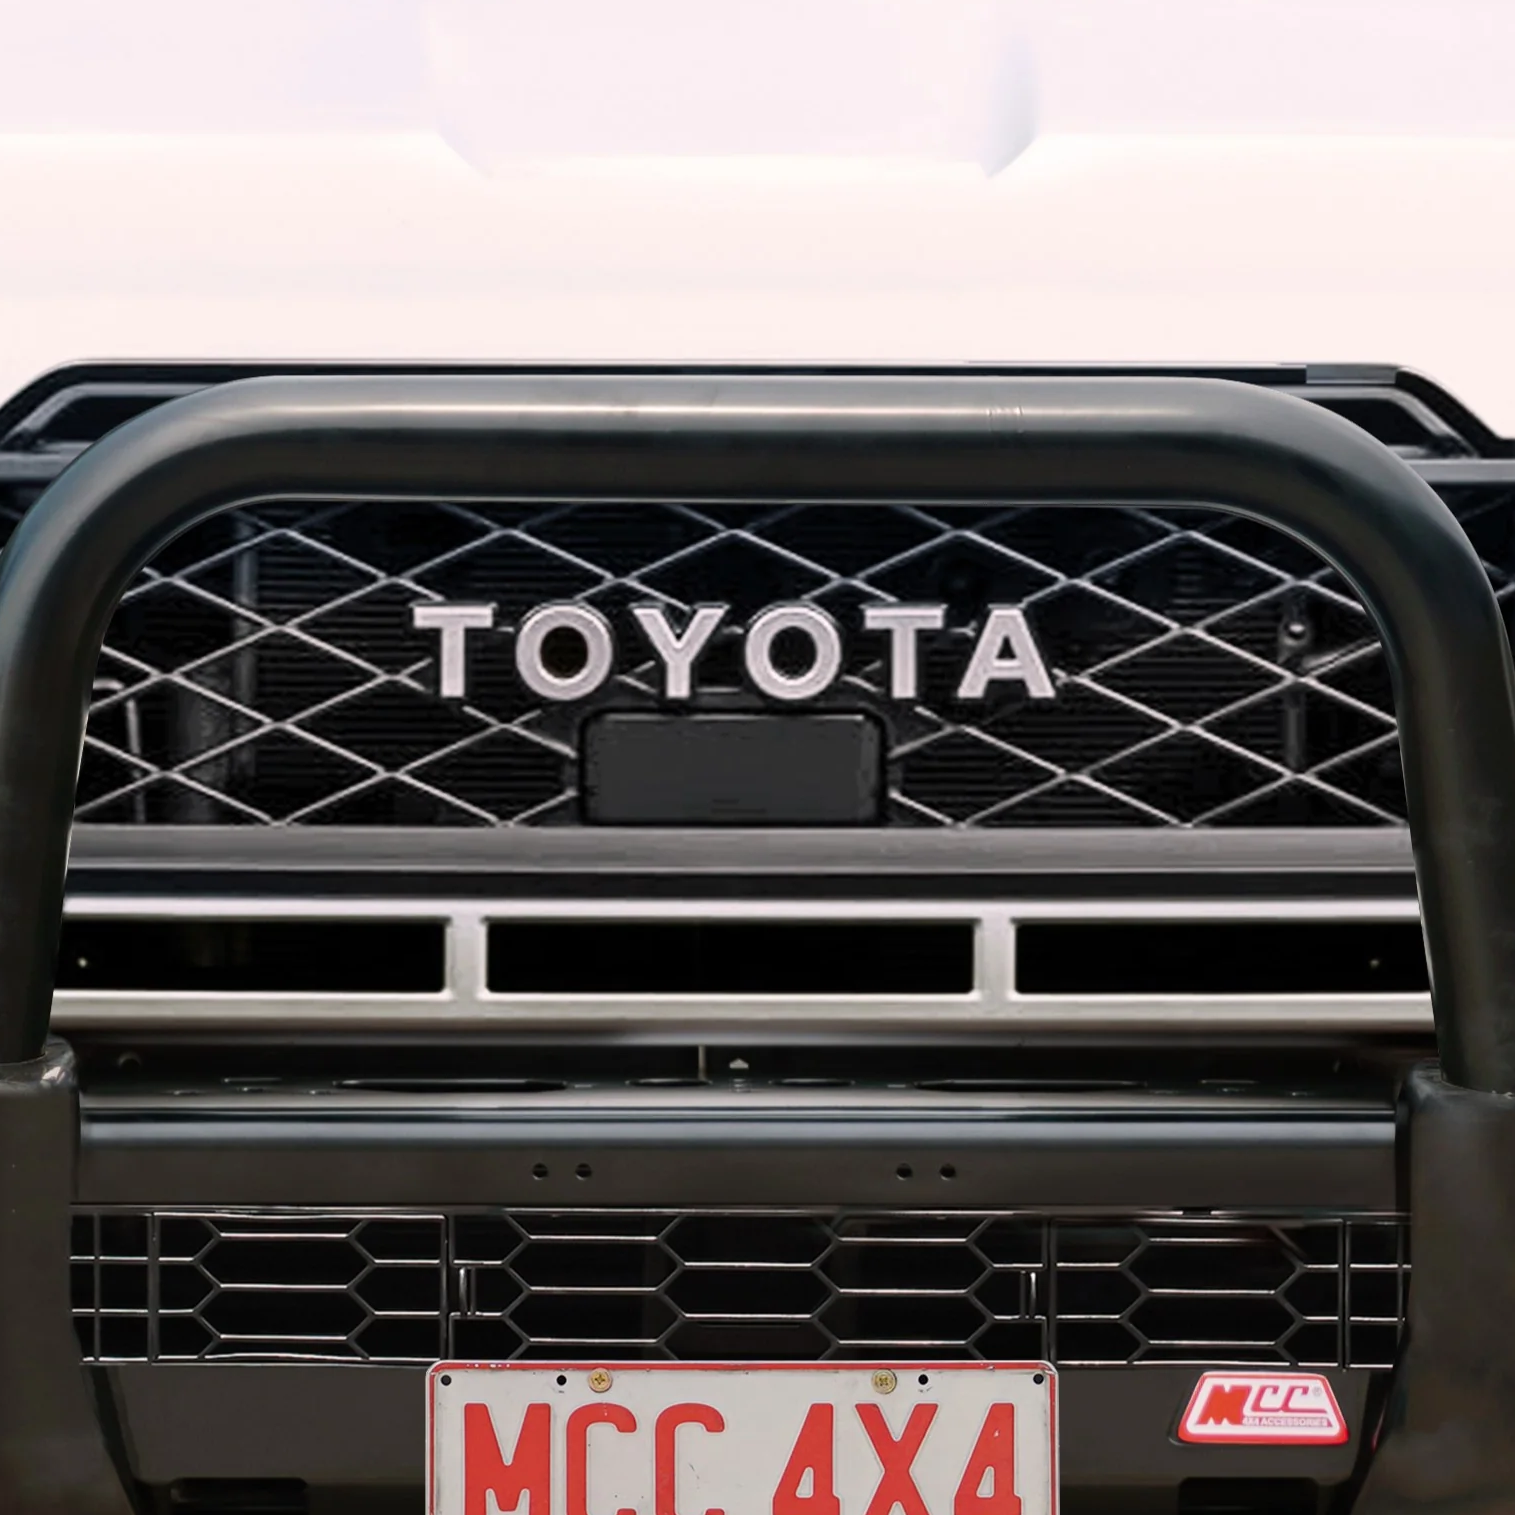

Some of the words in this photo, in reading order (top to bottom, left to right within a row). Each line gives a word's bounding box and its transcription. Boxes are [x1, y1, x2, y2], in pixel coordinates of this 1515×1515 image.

[412, 603, 1056, 701] TOYOTA
[1196, 1384, 1328, 1425] MCC
[1261, 1416, 1328, 1427] ACCESSORIES
